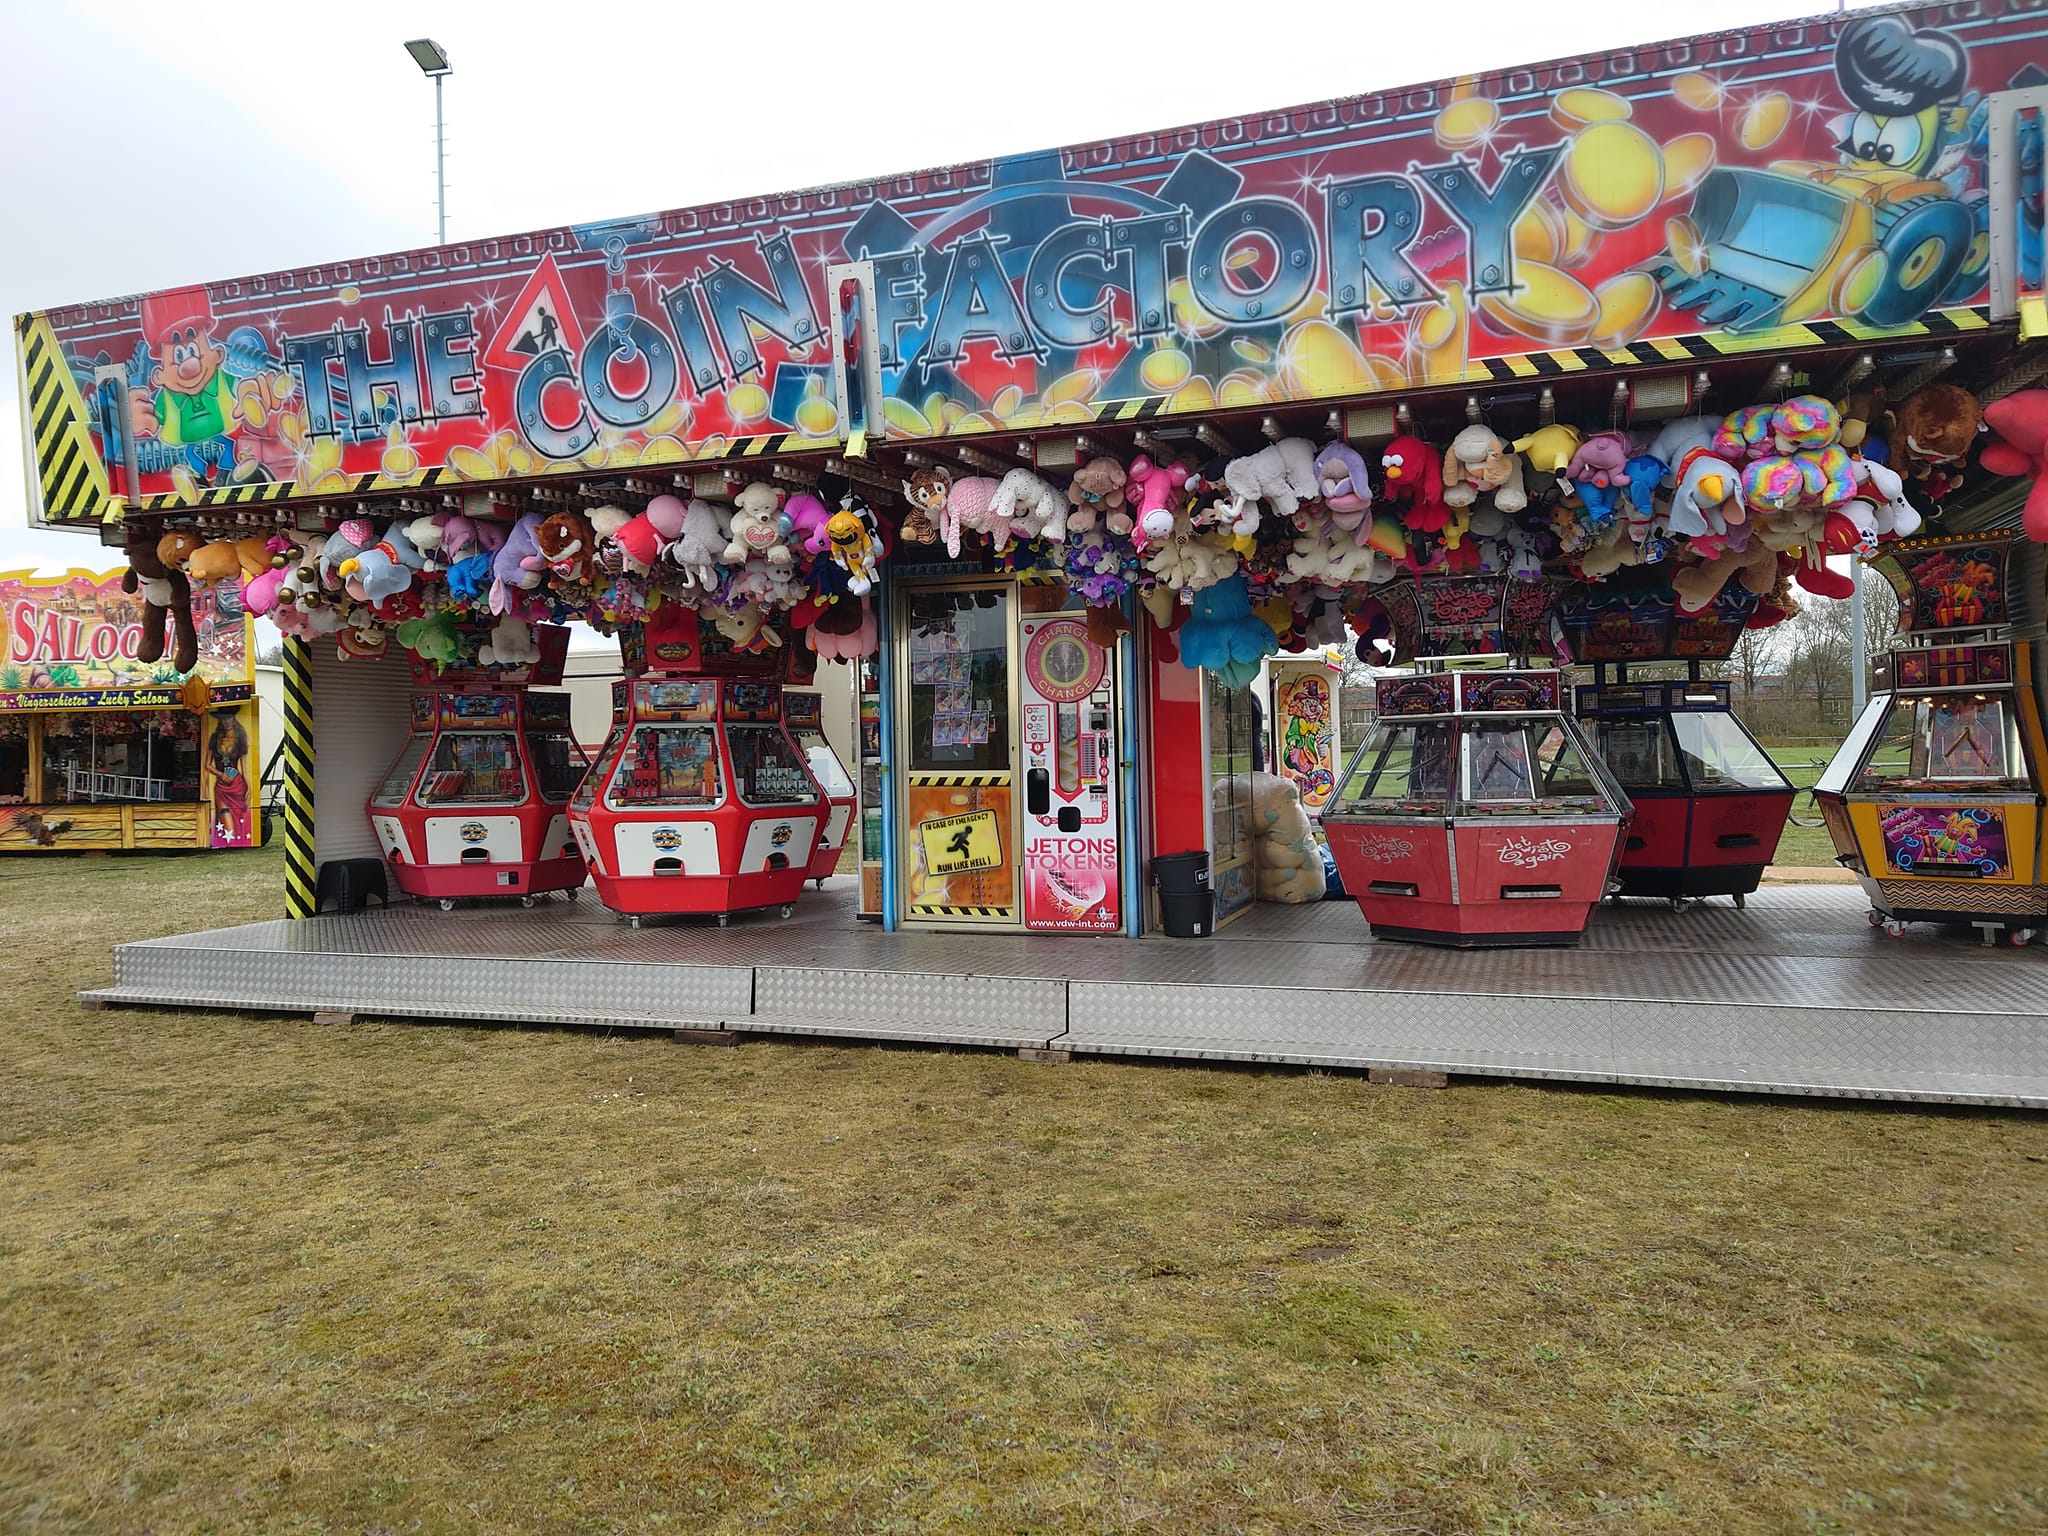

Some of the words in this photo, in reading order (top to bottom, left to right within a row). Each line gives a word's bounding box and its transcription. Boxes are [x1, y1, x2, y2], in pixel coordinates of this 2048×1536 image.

[280, 303, 486, 445] THE
[514, 227, 830, 460] COIN
[859, 137, 1572, 383] FACTORY
[1038, 679, 1093, 699] CHANGE
[98, 691, 129, 708] Lucky
[133, 690, 169, 705] Saloon
[932, 821, 947, 830] CASE
[955, 813, 989, 826] EMERGENCY
[1026, 837, 1117, 854] JETONS
[937, 864, 953, 873] RUN
[953, 861, 969, 870] LIKE
[969, 857, 987, 867] HELL
[1025, 854, 1117, 870] TOKENS
[1513, 851, 1566, 869] again
[1029, 919, 1116, 929] www.vdw-int.com
